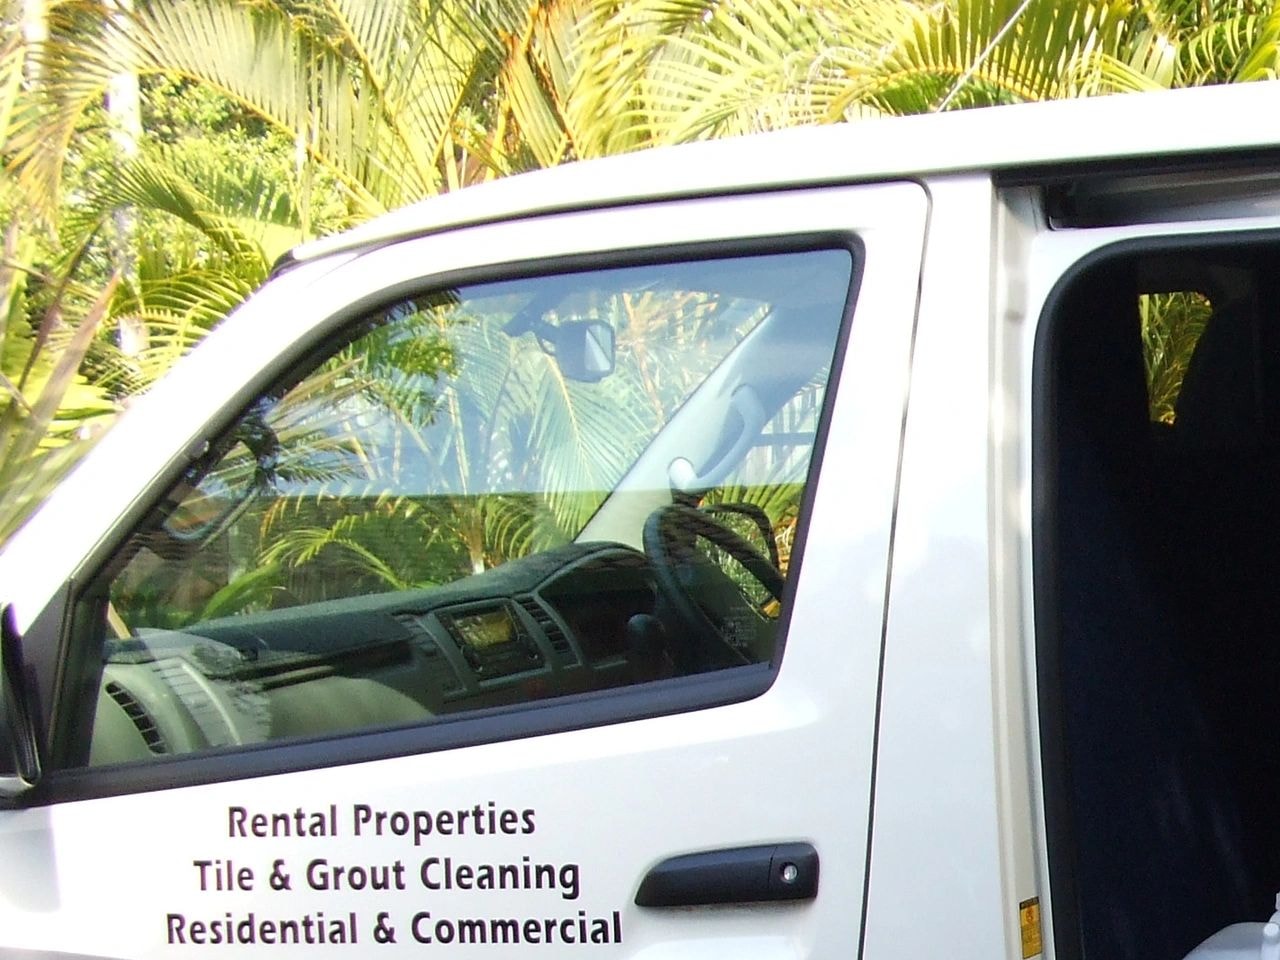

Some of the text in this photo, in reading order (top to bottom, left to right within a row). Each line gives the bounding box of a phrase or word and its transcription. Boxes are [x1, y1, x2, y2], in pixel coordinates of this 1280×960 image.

[228, 801, 536, 846] Rental Properties
[194, 856, 581, 900] Tile & Grout Cleaning
[166, 910, 623, 945] Residential & Commercial
